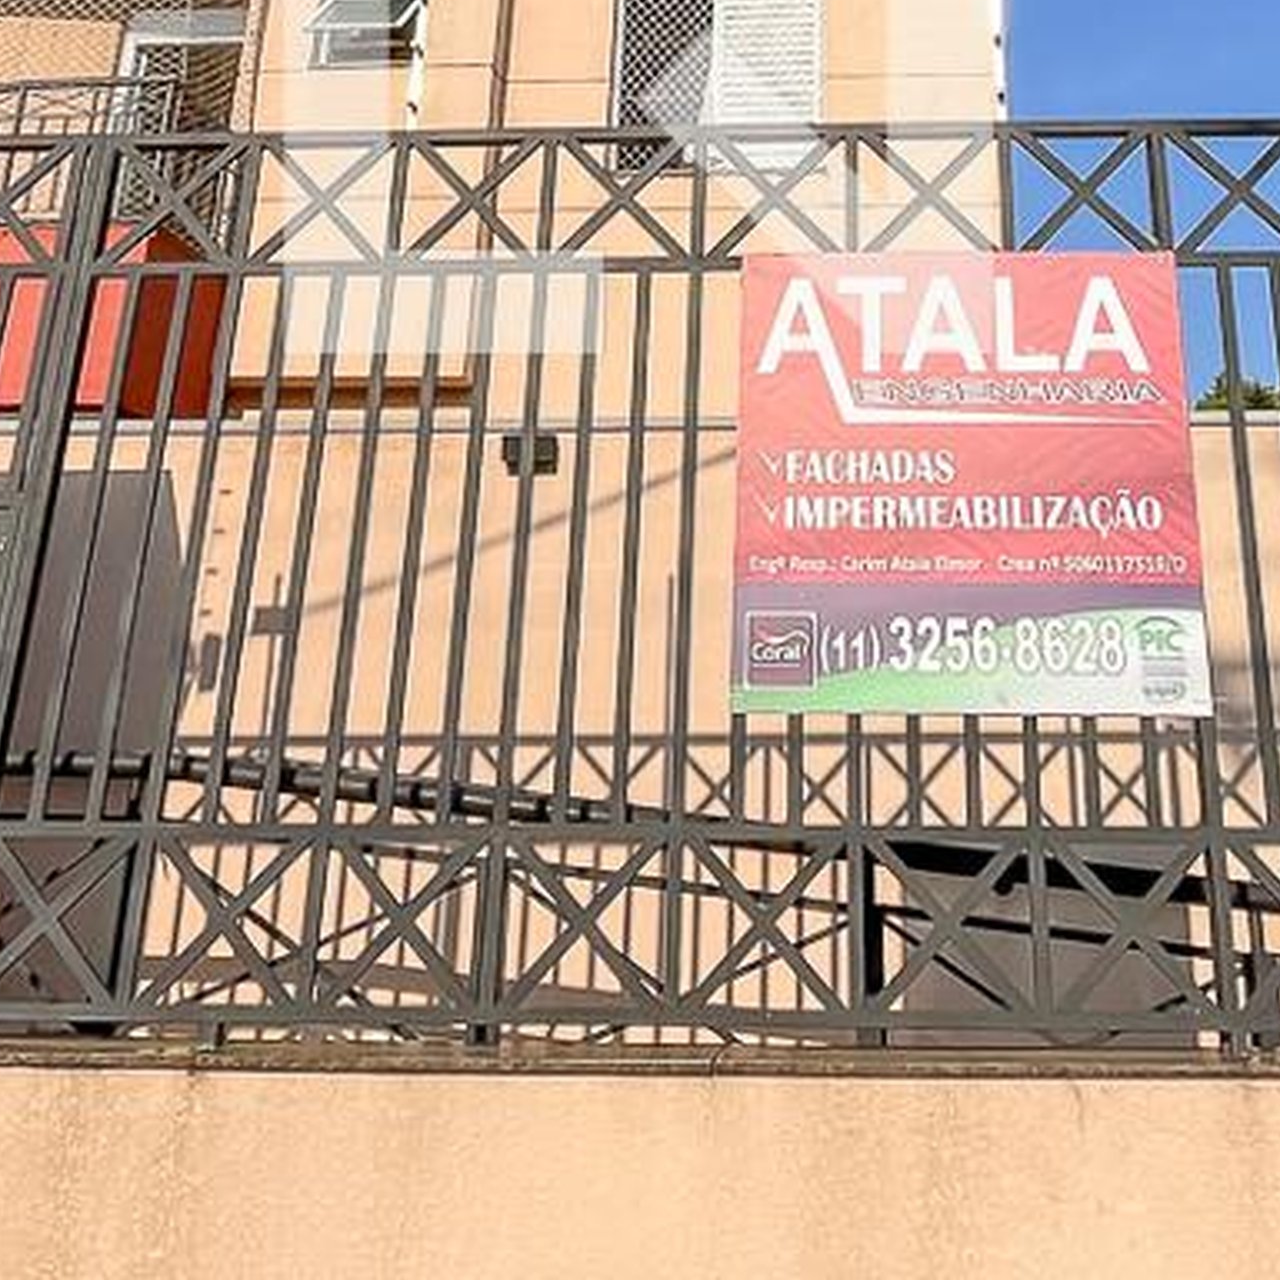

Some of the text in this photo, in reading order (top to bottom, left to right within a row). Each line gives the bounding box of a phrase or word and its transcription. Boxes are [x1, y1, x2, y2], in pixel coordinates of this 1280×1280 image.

[756, 275, 1150, 374] ATALA
[852, 377, 1163, 404] ENGENHARIA
[785, 450, 955, 484] FACHADAS
[784, 489, 1162, 538] IMPERMEABILIZAÇÃO
[752, 642, 801, 661] Coral
[820, 623, 880, 674] (11)
